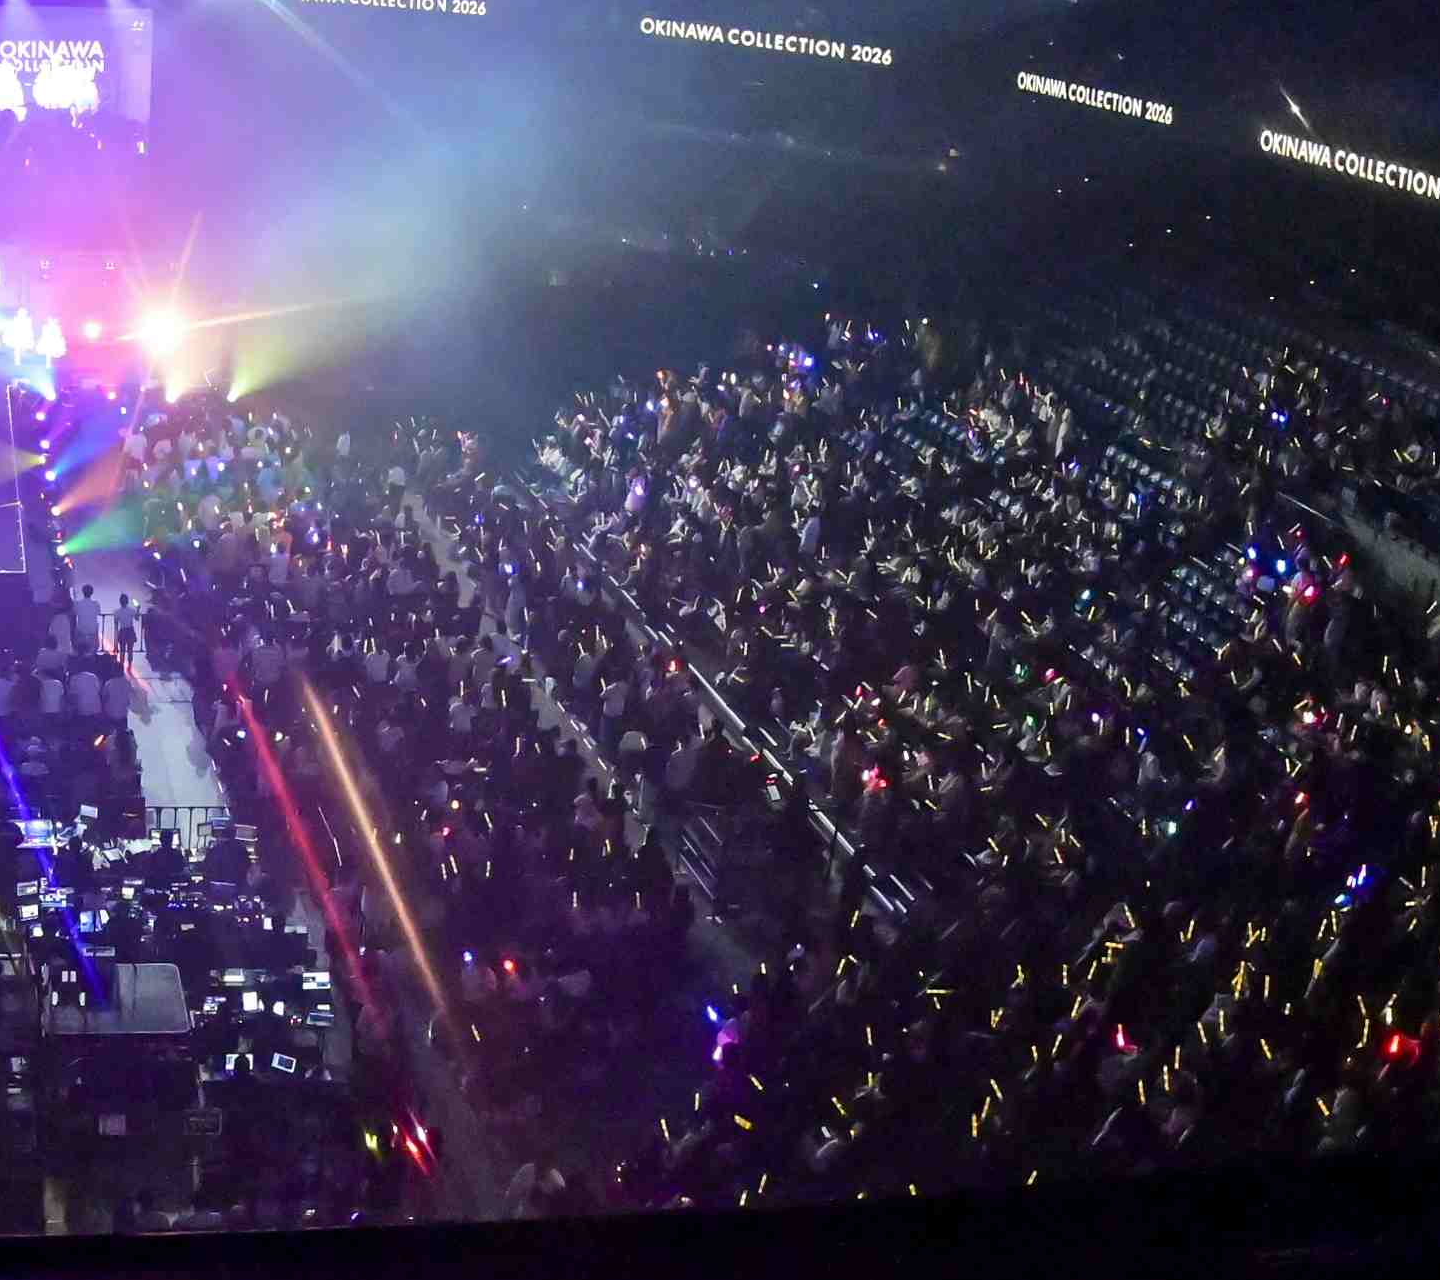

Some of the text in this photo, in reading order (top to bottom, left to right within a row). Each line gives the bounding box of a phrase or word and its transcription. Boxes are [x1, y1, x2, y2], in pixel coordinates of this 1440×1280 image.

[0, 40, 104, 58] OKINAWA
[640, 17, 892, 65] OKINAWA COLLECTION 2026
[1017, 71, 1173, 125] OKINAWA COLLECTION 2026
[1259, 128, 1332, 169] OKINAWA
